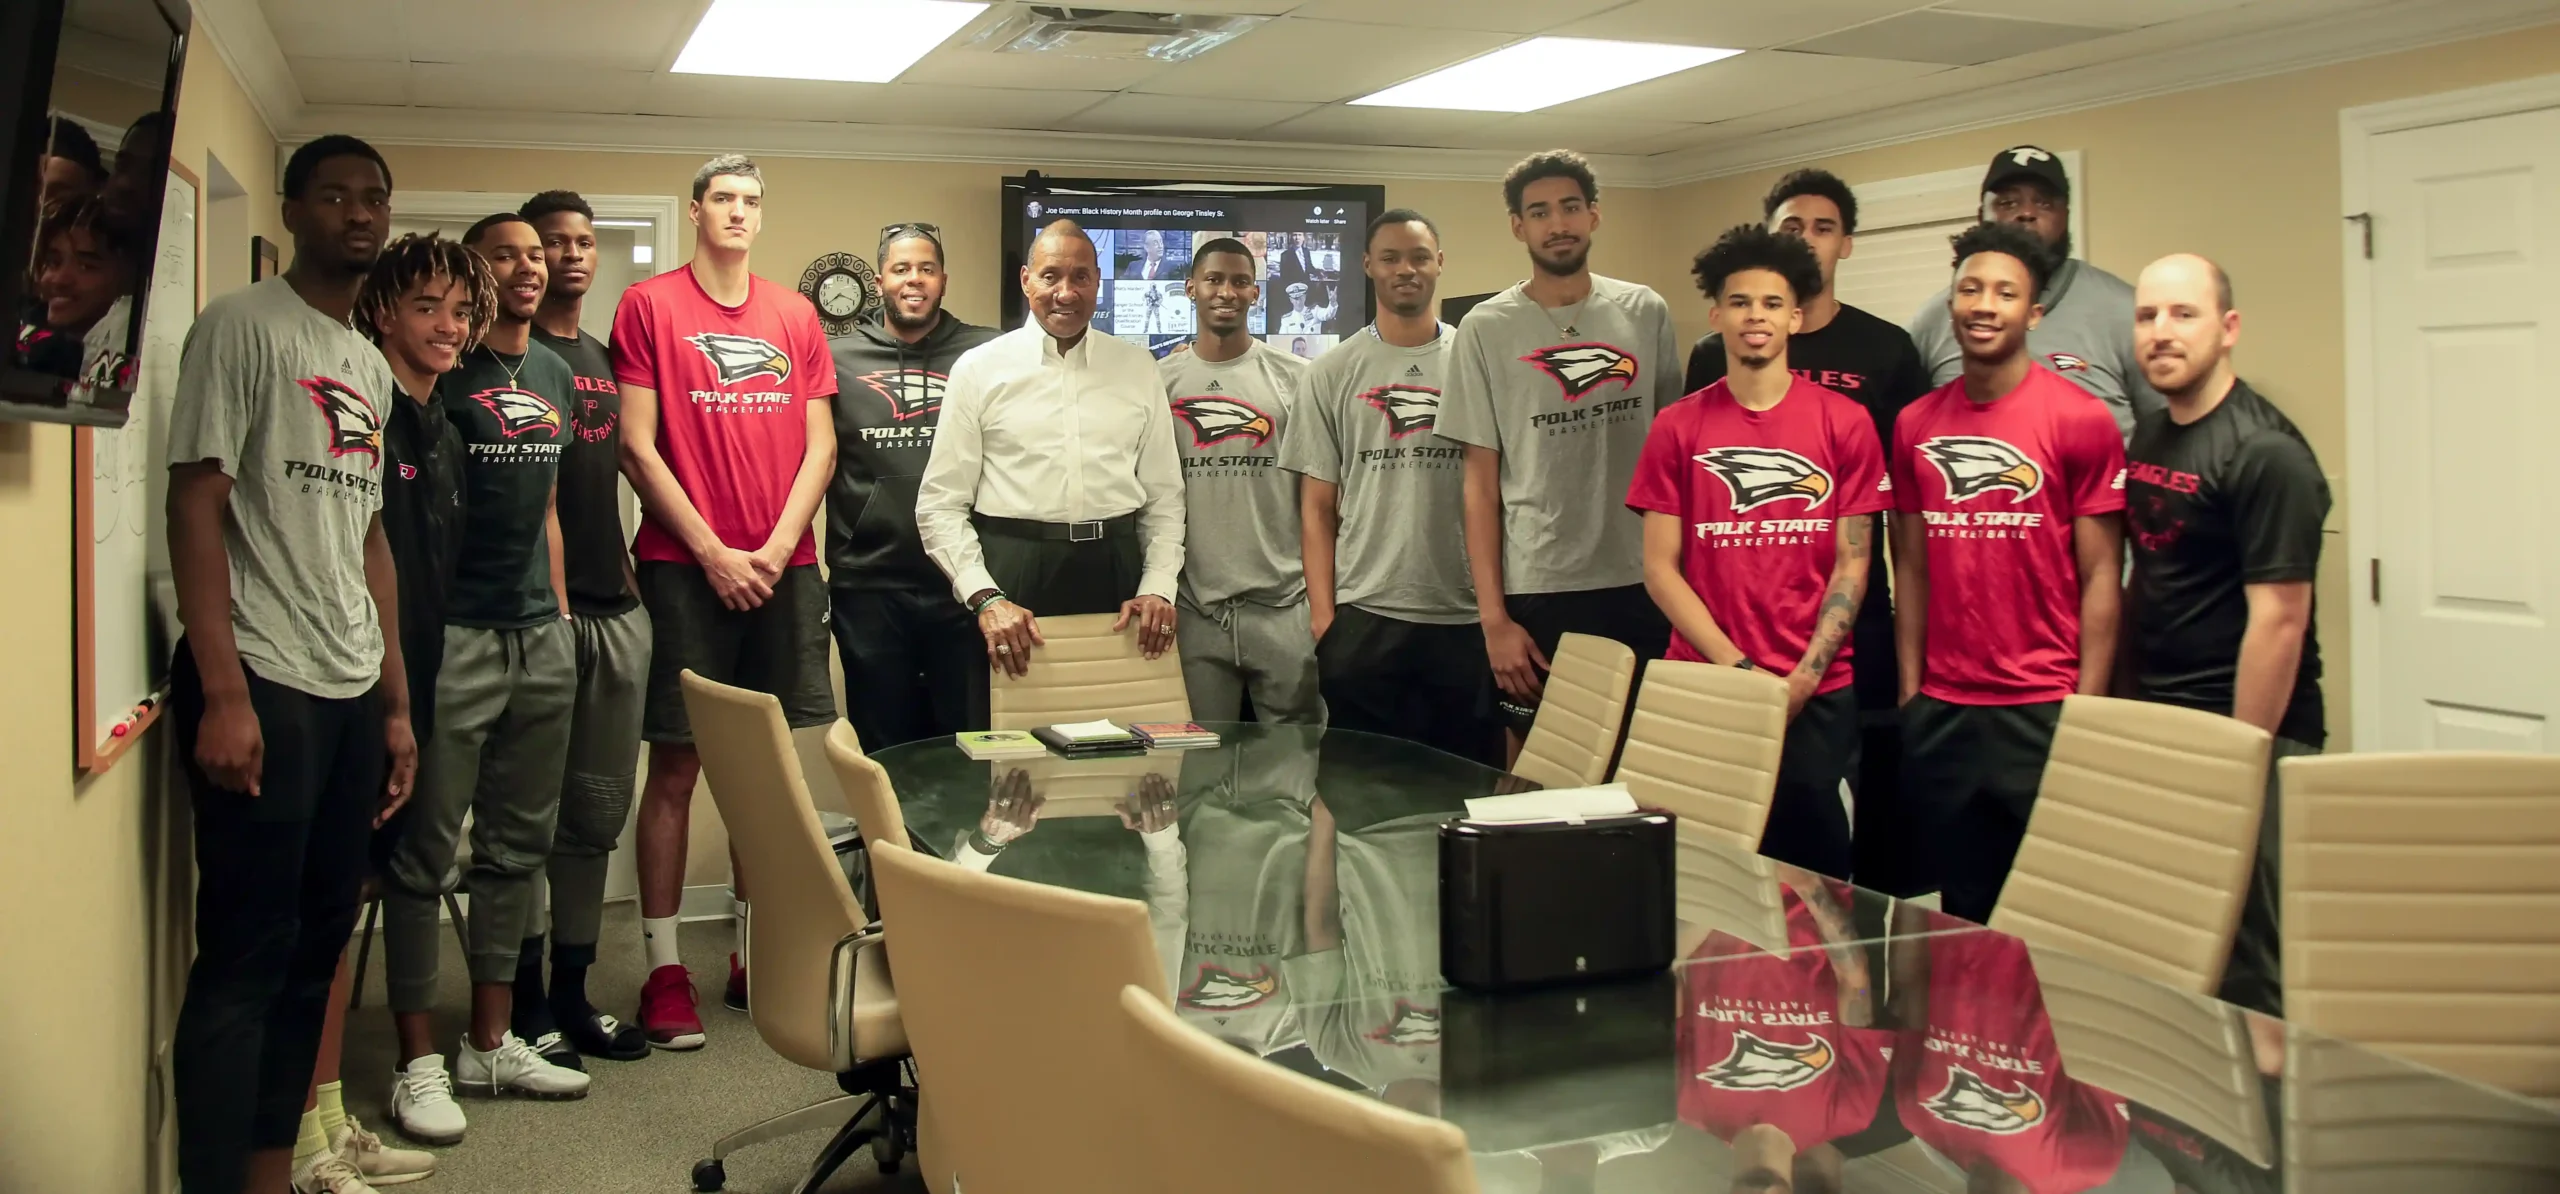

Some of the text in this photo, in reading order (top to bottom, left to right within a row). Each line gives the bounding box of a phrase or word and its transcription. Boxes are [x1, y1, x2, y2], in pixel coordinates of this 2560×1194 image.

[1082, 207, 1100, 215] Black
[1100, 208, 1122, 216] History
[1123, 208, 1142, 216] Month
[1143, 208, 1163, 217] profile
[1172, 209, 1194, 218] George
[1194, 209, 1216, 218] Tinsley
[573, 375, 619, 395] GLES
[688, 390, 793, 404] POLK STATE
[1529, 396, 1643, 429] POLK STATE
[858, 427, 915, 442] POLK
[468, 443, 563, 455] POLK STATE
[1358, 447, 1407, 464] POLK
[482, 455, 559, 463] BASKETBALL
[1217, 456, 1275, 467] STATE
[284, 460, 345, 487] POLK
[1371, 461, 1460, 472] BASKETBALL
[1187, 469, 1264, 479] ASKETBALL
[1972, 511, 2044, 527] STATE
[1694, 518, 1833, 539] POLK STATE
